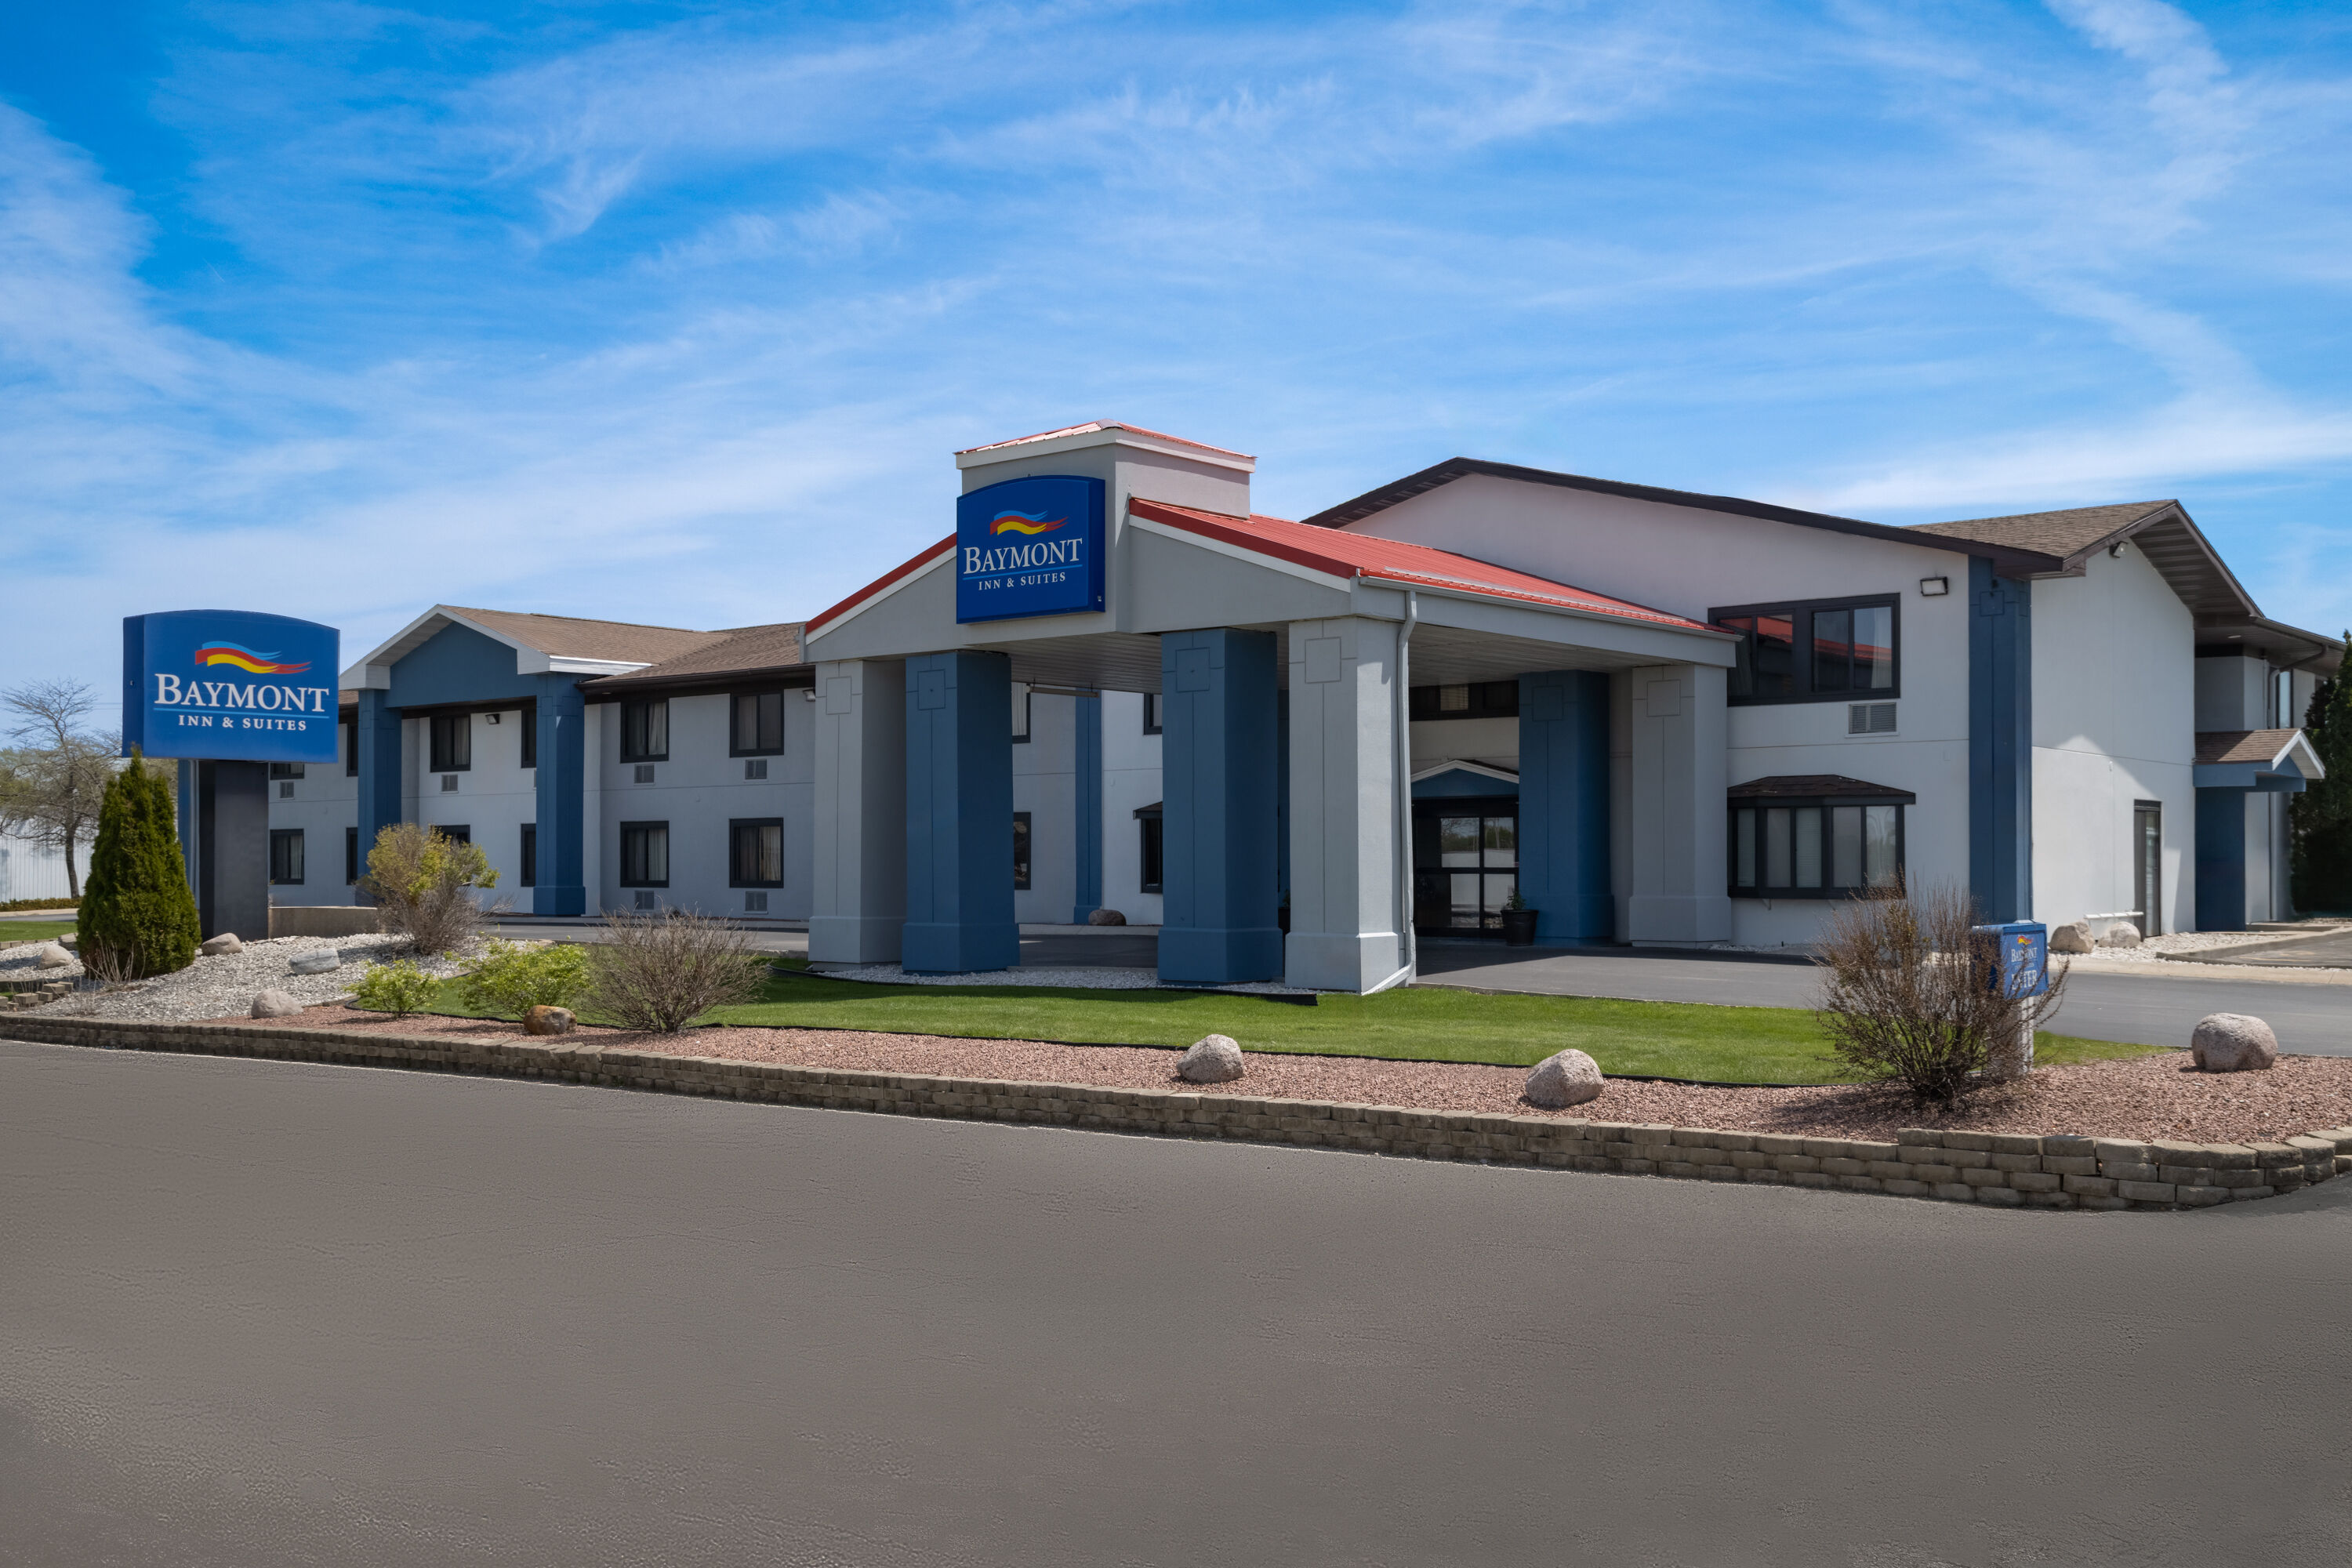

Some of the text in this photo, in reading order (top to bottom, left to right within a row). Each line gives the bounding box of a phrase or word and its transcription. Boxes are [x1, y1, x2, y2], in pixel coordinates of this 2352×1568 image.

[963, 537, 1083, 575] BAYMONT
[978, 572, 1066, 590] INN & SUITES
[154, 673, 329, 713] BAYMONT
[178, 714, 307, 731] INN & SUITES
[2011, 947, 2038, 963] BAYNT
